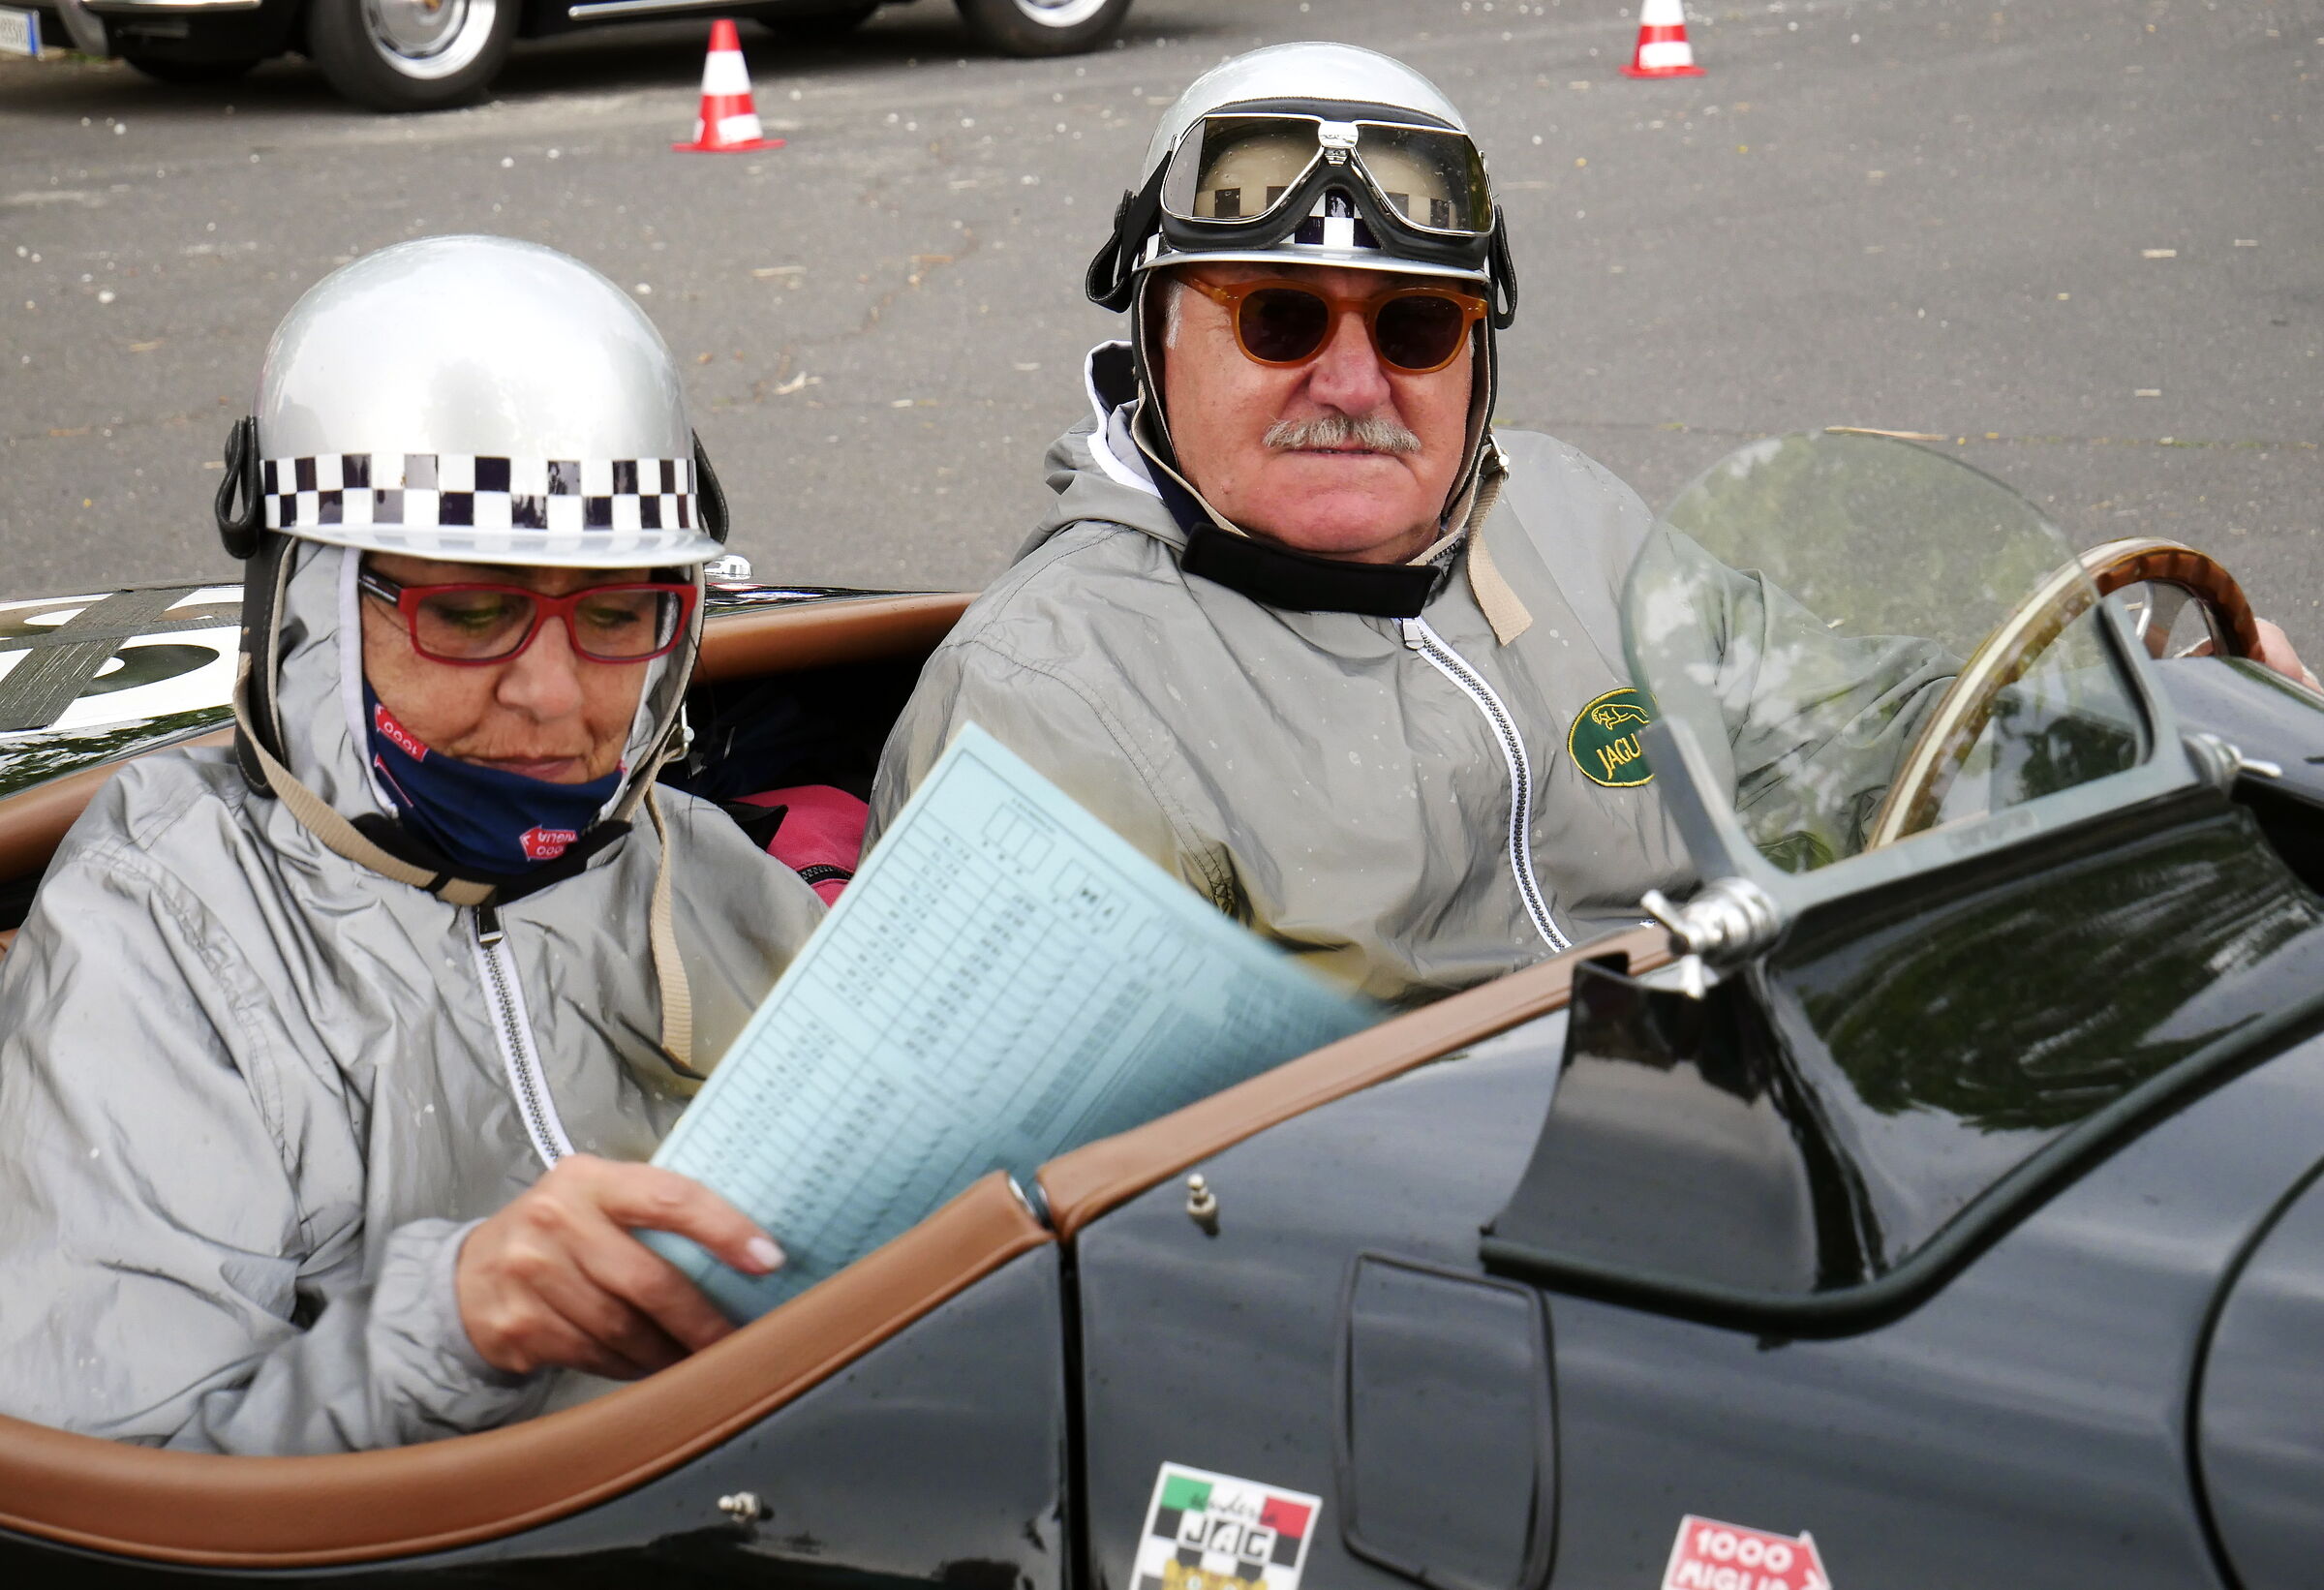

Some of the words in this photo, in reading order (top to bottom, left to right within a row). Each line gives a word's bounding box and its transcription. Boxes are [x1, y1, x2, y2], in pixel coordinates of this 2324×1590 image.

[383, 721, 417, 754] 1000
[1596, 731, 1643, 780] JAGU
[1697, 1528, 1793, 1574] 1000
